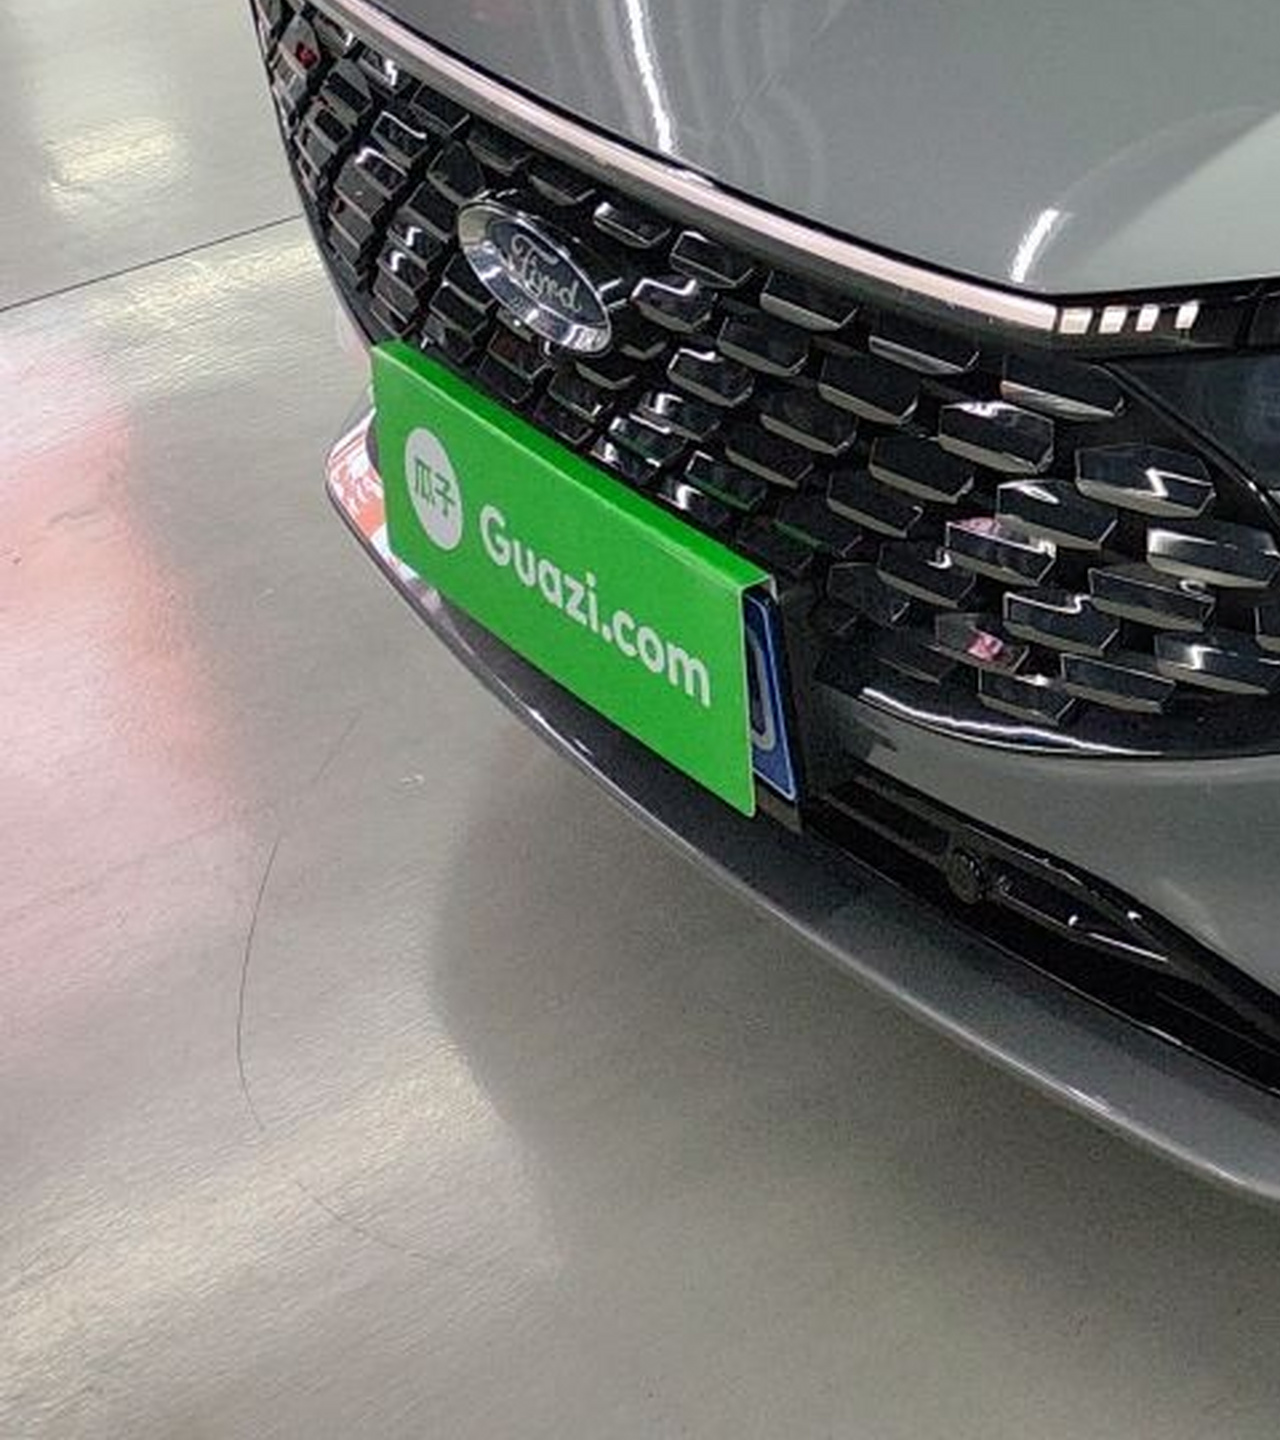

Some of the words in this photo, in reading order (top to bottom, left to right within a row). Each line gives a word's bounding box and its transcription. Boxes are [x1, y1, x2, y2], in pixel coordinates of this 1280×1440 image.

[507, 234, 583, 312] Ford
[414, 457, 455, 518] 瓜子
[480, 504, 711, 708] Guazi.com
